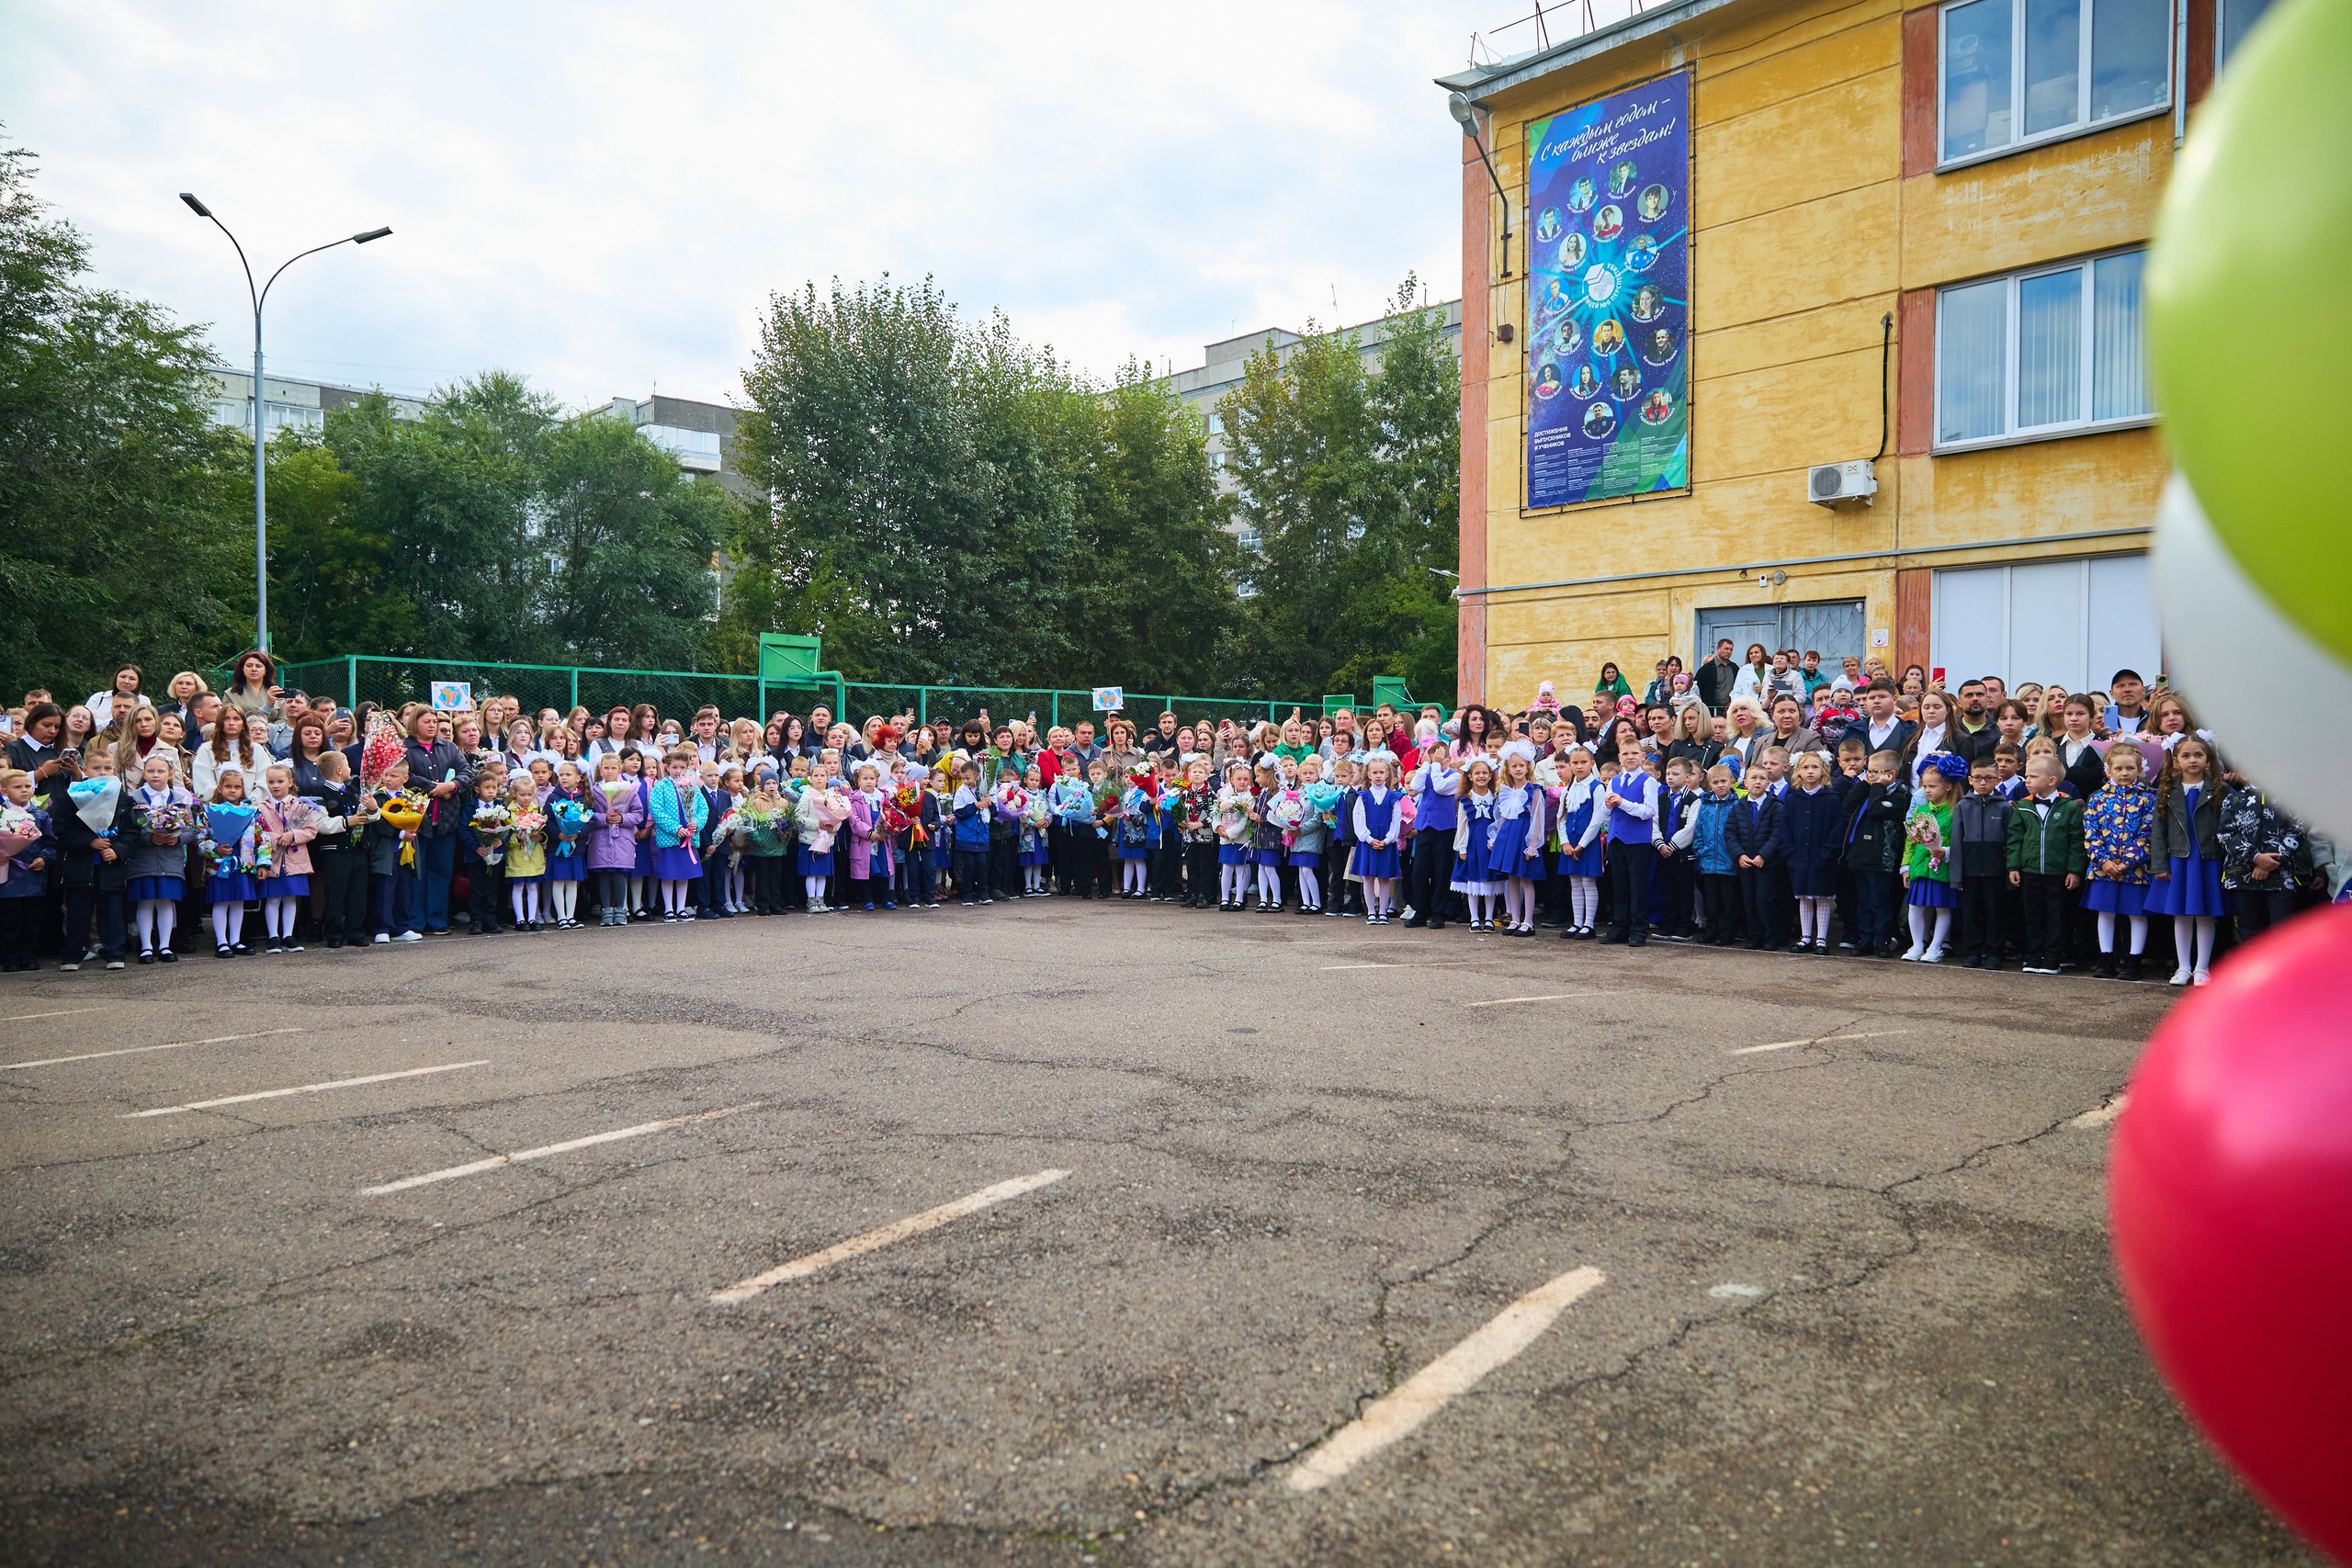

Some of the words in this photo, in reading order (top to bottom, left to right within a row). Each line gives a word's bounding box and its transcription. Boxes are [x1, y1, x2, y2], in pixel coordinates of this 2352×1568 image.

[1541, 141, 1552, 162] С
[1551, 119, 1612, 156] каждым
[1615, 99, 1658, 129] годом
[1596, 150, 1608, 164] к
[1608, 117, 1677, 160] звездам!
[1571, 131, 1620, 163] ближе
[1533, 425, 1568, 438] ДОСТИЖЕНИЯ
[1533, 432, 1571, 445] ВЫПУСКНИКОВ
[1538, 440, 1565, 450] УЧЕНИКОВ
